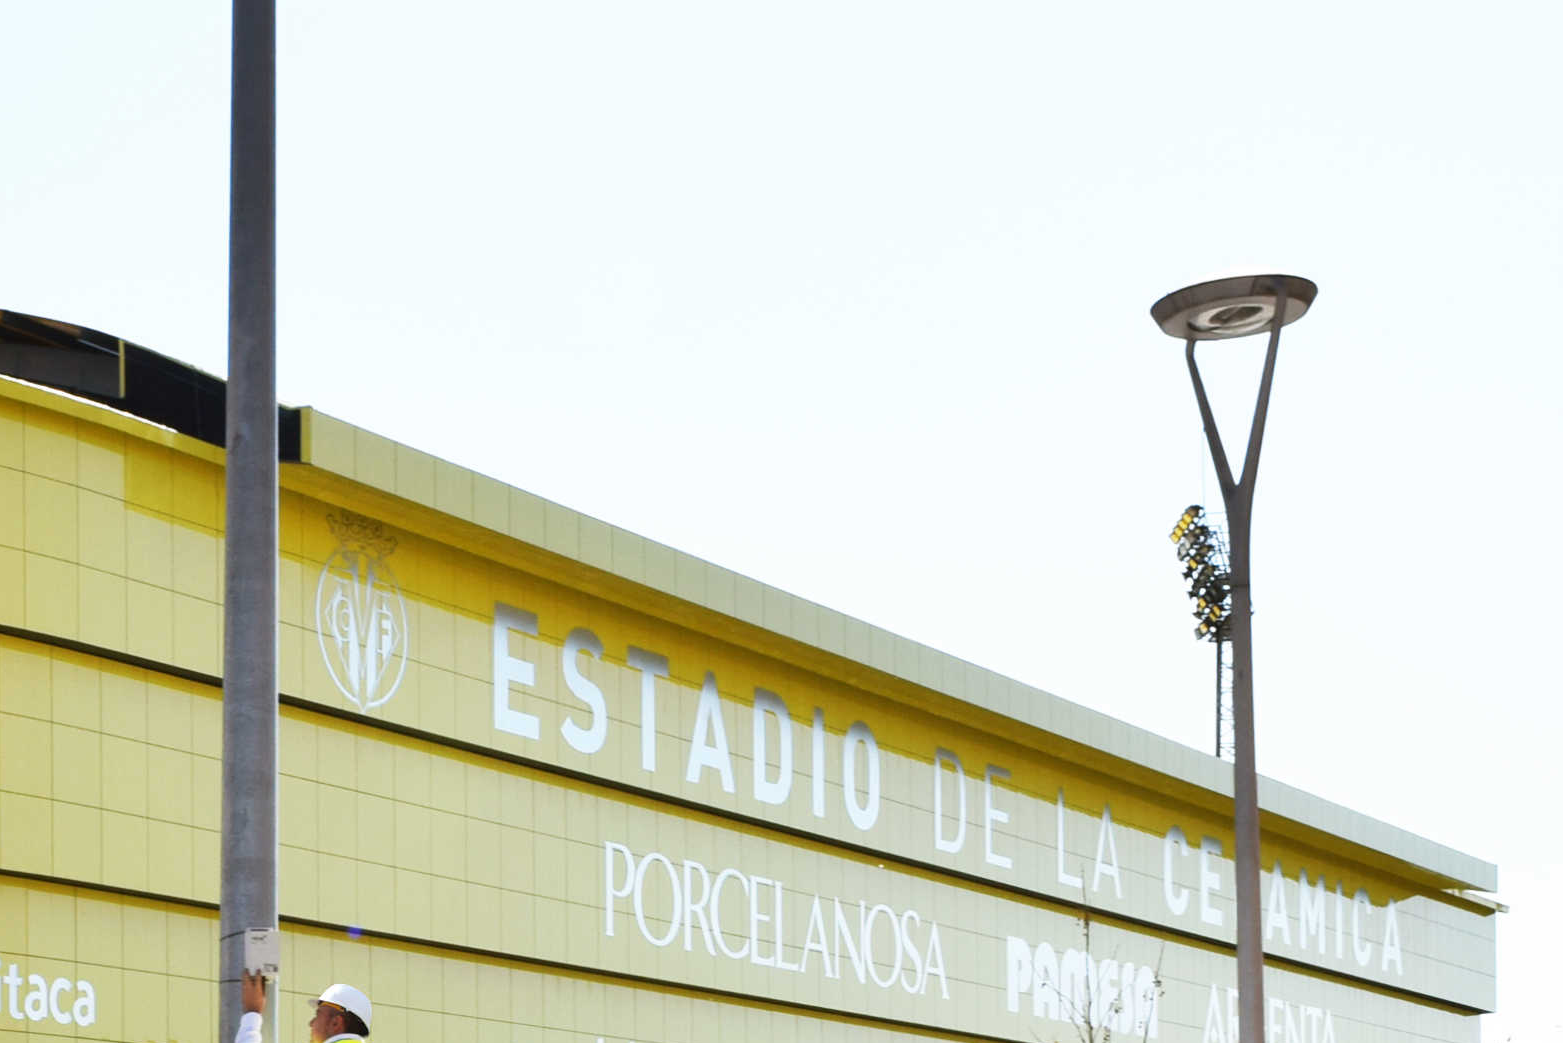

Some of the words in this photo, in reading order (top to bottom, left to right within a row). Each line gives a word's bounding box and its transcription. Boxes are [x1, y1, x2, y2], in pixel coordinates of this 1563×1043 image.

[493, 602, 880, 831] ESTADIO
[934, 747, 1013, 869] DE
[1057, 786, 1123, 899] LA
[1164, 824, 1404, 977] CEAMICA
[604, 841, 950, 1000] PORCELANOSA
[1006, 935, 1158, 1039] PAMESA
